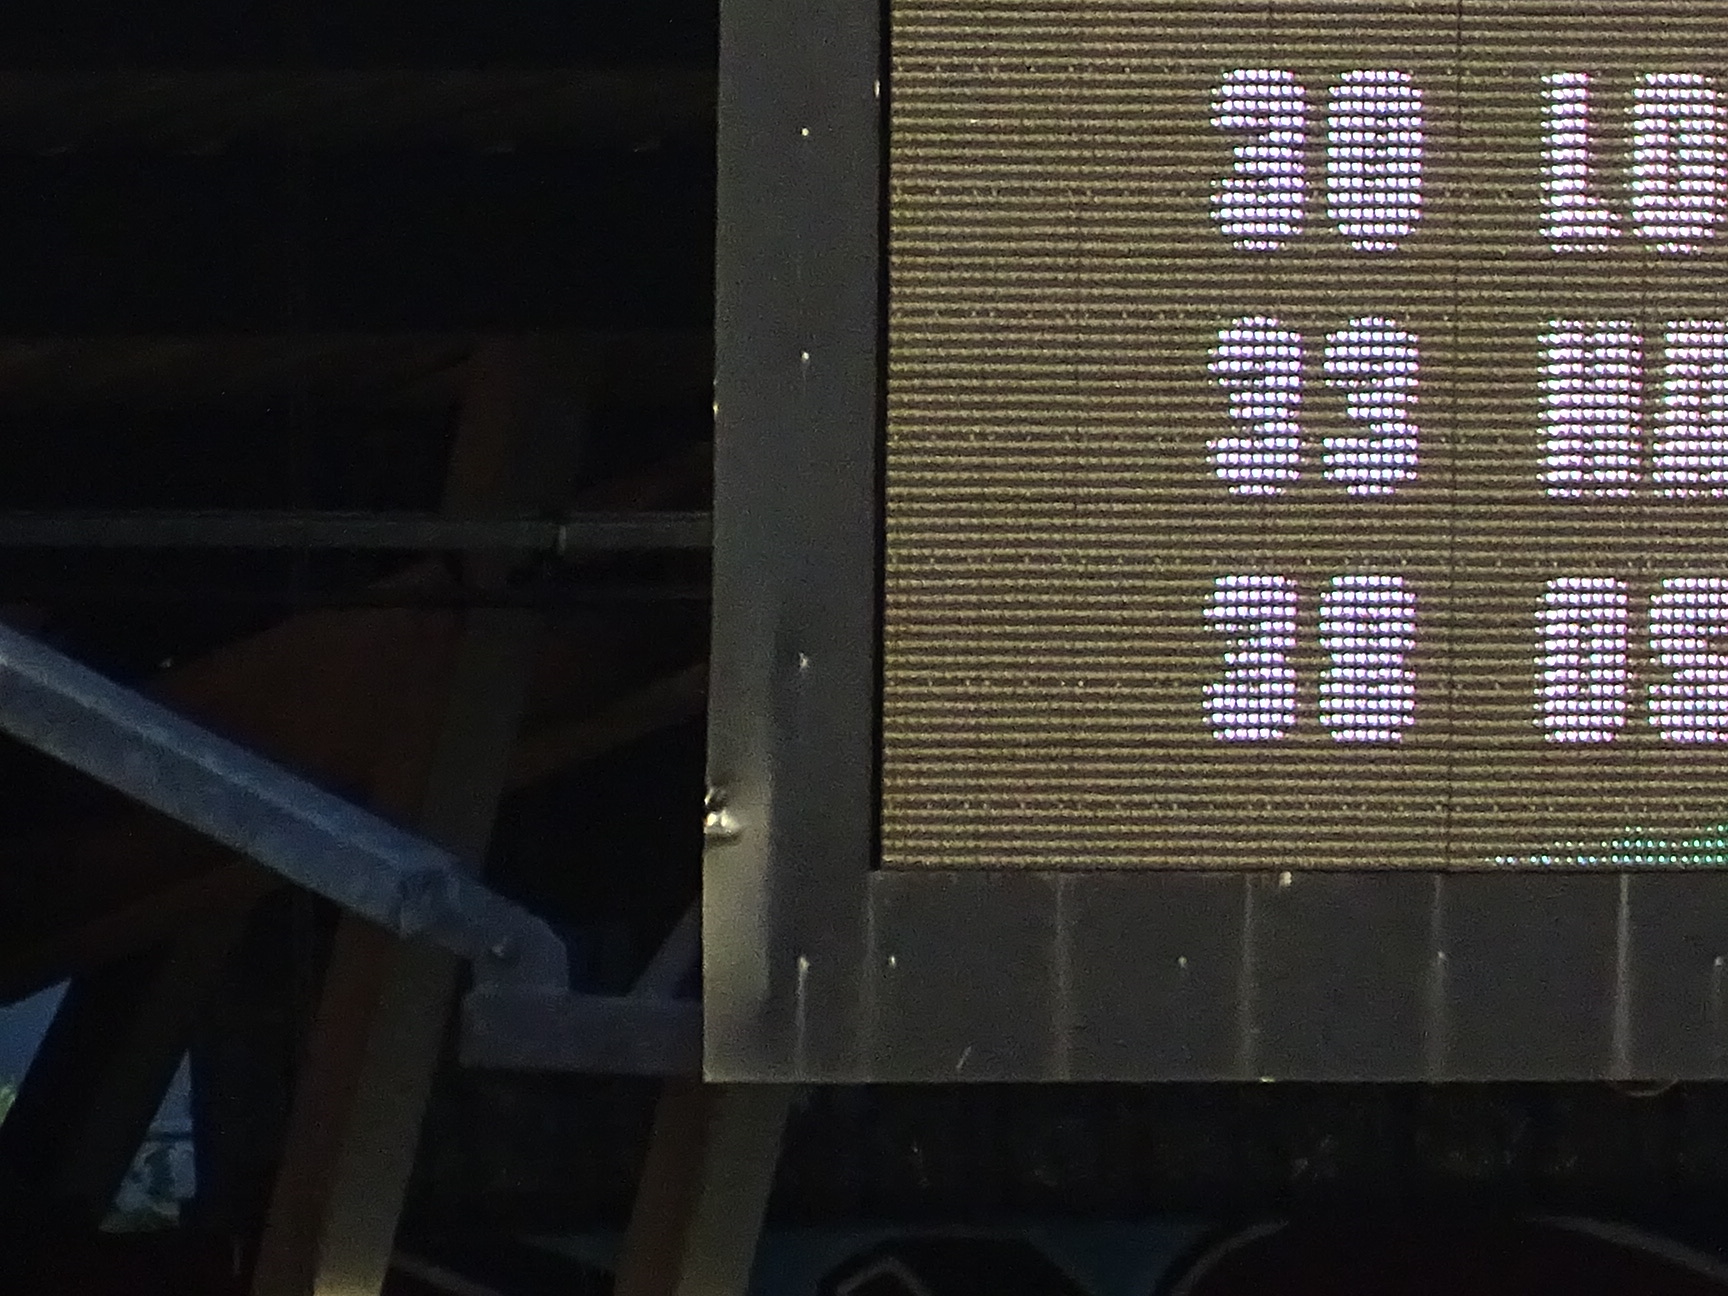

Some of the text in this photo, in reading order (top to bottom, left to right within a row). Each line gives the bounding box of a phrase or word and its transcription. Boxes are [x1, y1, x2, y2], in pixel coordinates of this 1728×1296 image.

[1209, 68, 1423, 251] 30
[1205, 316, 1420, 495] 33
[1201, 575, 1415, 741] 38
